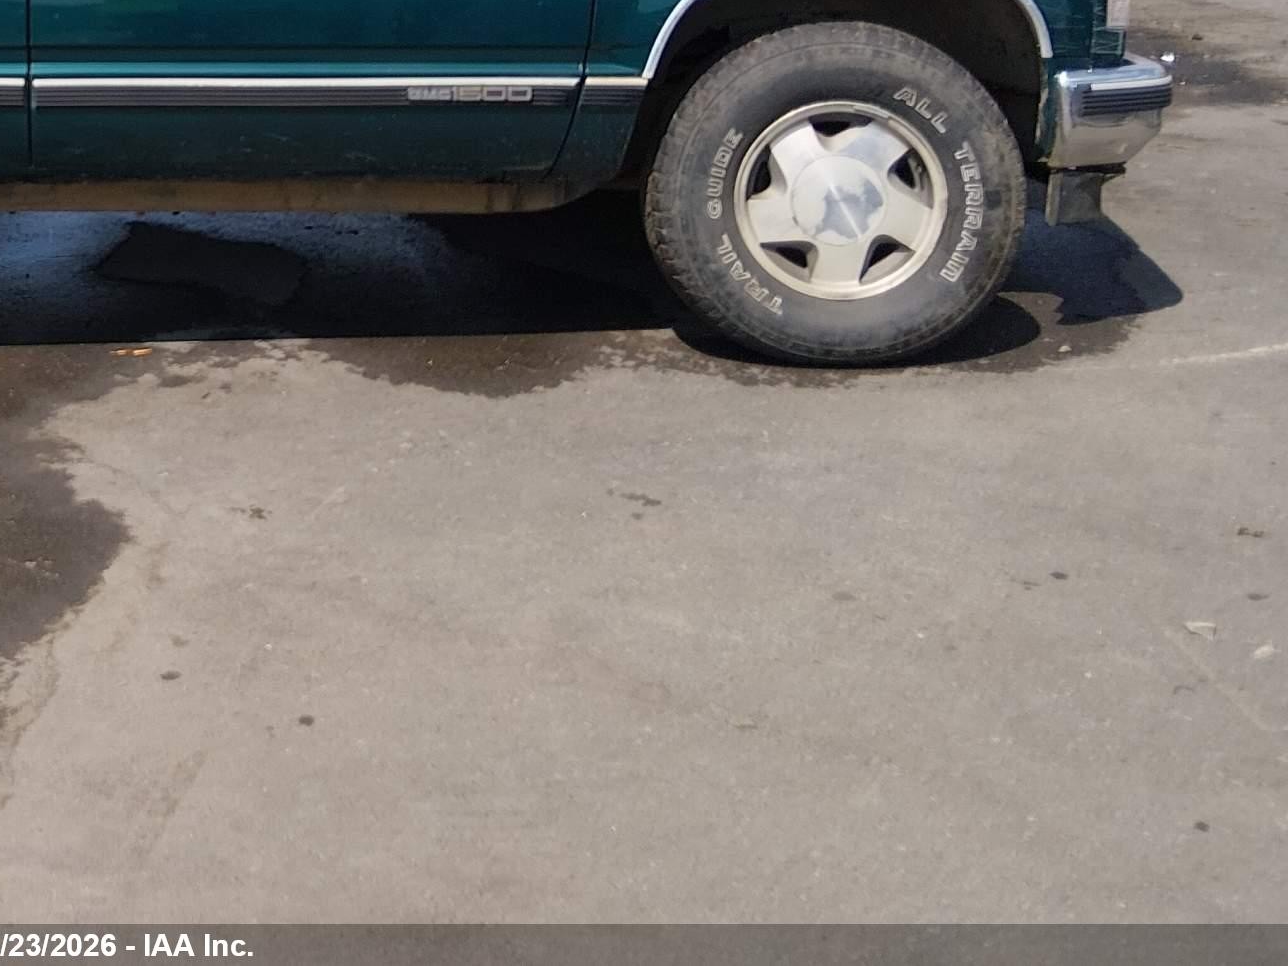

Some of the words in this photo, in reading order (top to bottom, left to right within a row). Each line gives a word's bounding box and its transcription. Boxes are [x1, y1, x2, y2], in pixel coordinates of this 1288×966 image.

[452, 86, 532, 102] 1500
[705, 127, 744, 220] GUIDE
[892, 86, 949, 135] ALL
[940, 141, 984, 282] TERRAIN
[716, 233, 785, 315] TRAIL
